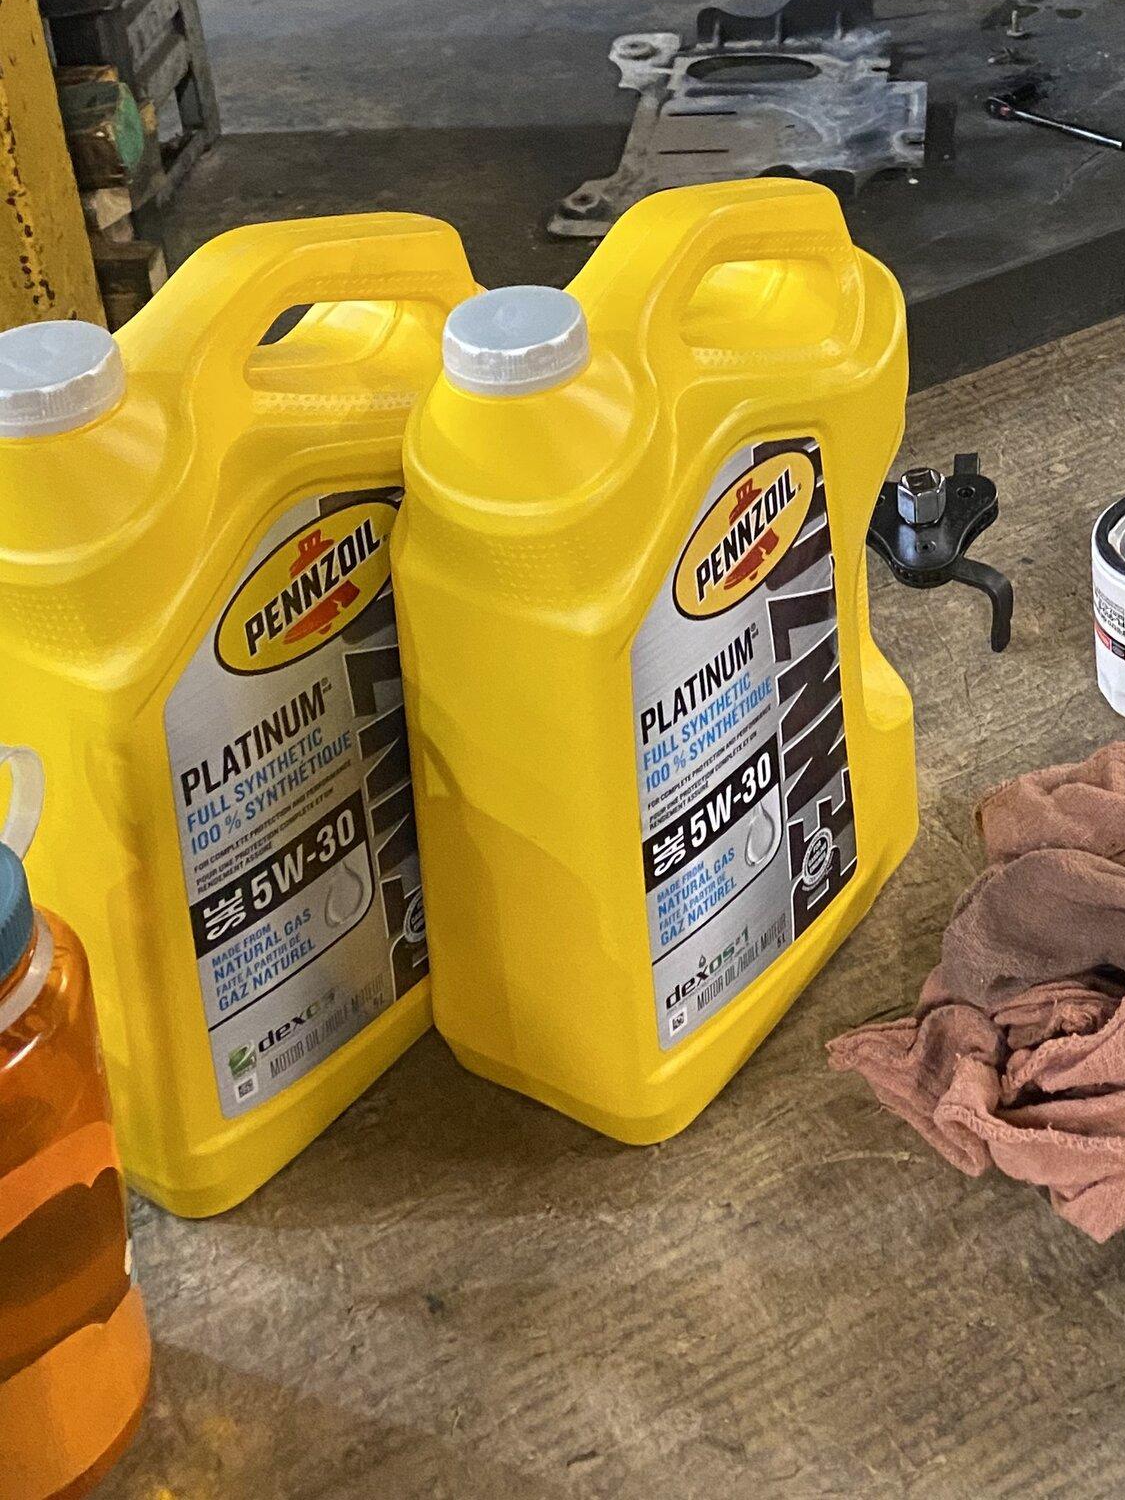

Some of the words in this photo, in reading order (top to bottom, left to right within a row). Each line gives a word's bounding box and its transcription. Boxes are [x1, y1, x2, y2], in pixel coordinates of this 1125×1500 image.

[695, 467, 798, 602] PENNZOIL
[244, 519, 381, 656] PENNZOIL
[643, 732, 679, 771] FULL
[682, 672, 751, 743] SYNTHETIC
[187, 795, 231, 833] FULL
[233, 727, 323, 802] SYNTHETIC
[646, 763, 670, 792] 100
[673, 750, 687, 772] %
[648, 797, 660, 811] FOR
[660, 774, 691, 802] COMPLETE
[691, 746, 725, 777] PROTECTION
[679, 767, 715, 800] PROTECTION
[191, 822, 222, 855] 100
[225, 810, 242, 834] %
[194, 859, 210, 874] FOR
[209, 835, 249, 862] COMPLETE
[249, 805, 292, 838] PROTECTION
[649, 801, 686, 830] RENDEMENT
[652, 825, 687, 877] SAE
[690, 752, 772, 848] 5W-30
[196, 868, 218, 886] POUR
[235, 831, 279, 863] PROTECTION
[197, 863, 244, 894] RENDEMENT
[203, 887, 248, 941] SAE
[250, 808, 356, 910] 5W-30
[657, 880, 681, 902] MADE
[681, 860, 705, 884] FROM
[657, 870, 712, 918] NATURAL
[713, 847, 736, 875] GAS
[659, 908, 682, 931] FAITE
[688, 880, 716, 907] PARTIR
[715, 871, 727, 889] DE
[660, 919, 686, 946] GAZ
[687, 876, 738, 926] NATUREL
[211, 942, 242, 967] MADE
[243, 920, 272, 946] FROM
[213, 931, 282, 983] NATURAL
[283, 907, 312, 936] GAS
[216, 976, 244, 998] FAITE
[253, 943, 288, 972] PARTIR
[288, 933, 302, 950] DE
[218, 983, 249, 1011] GAZ
[252, 938, 317, 991] NATUREL
[696, 974, 725, 1012] MOTOR
[760, 912, 787, 949] MOTEUR
[269, 1040, 305, 1079] MOTOR
